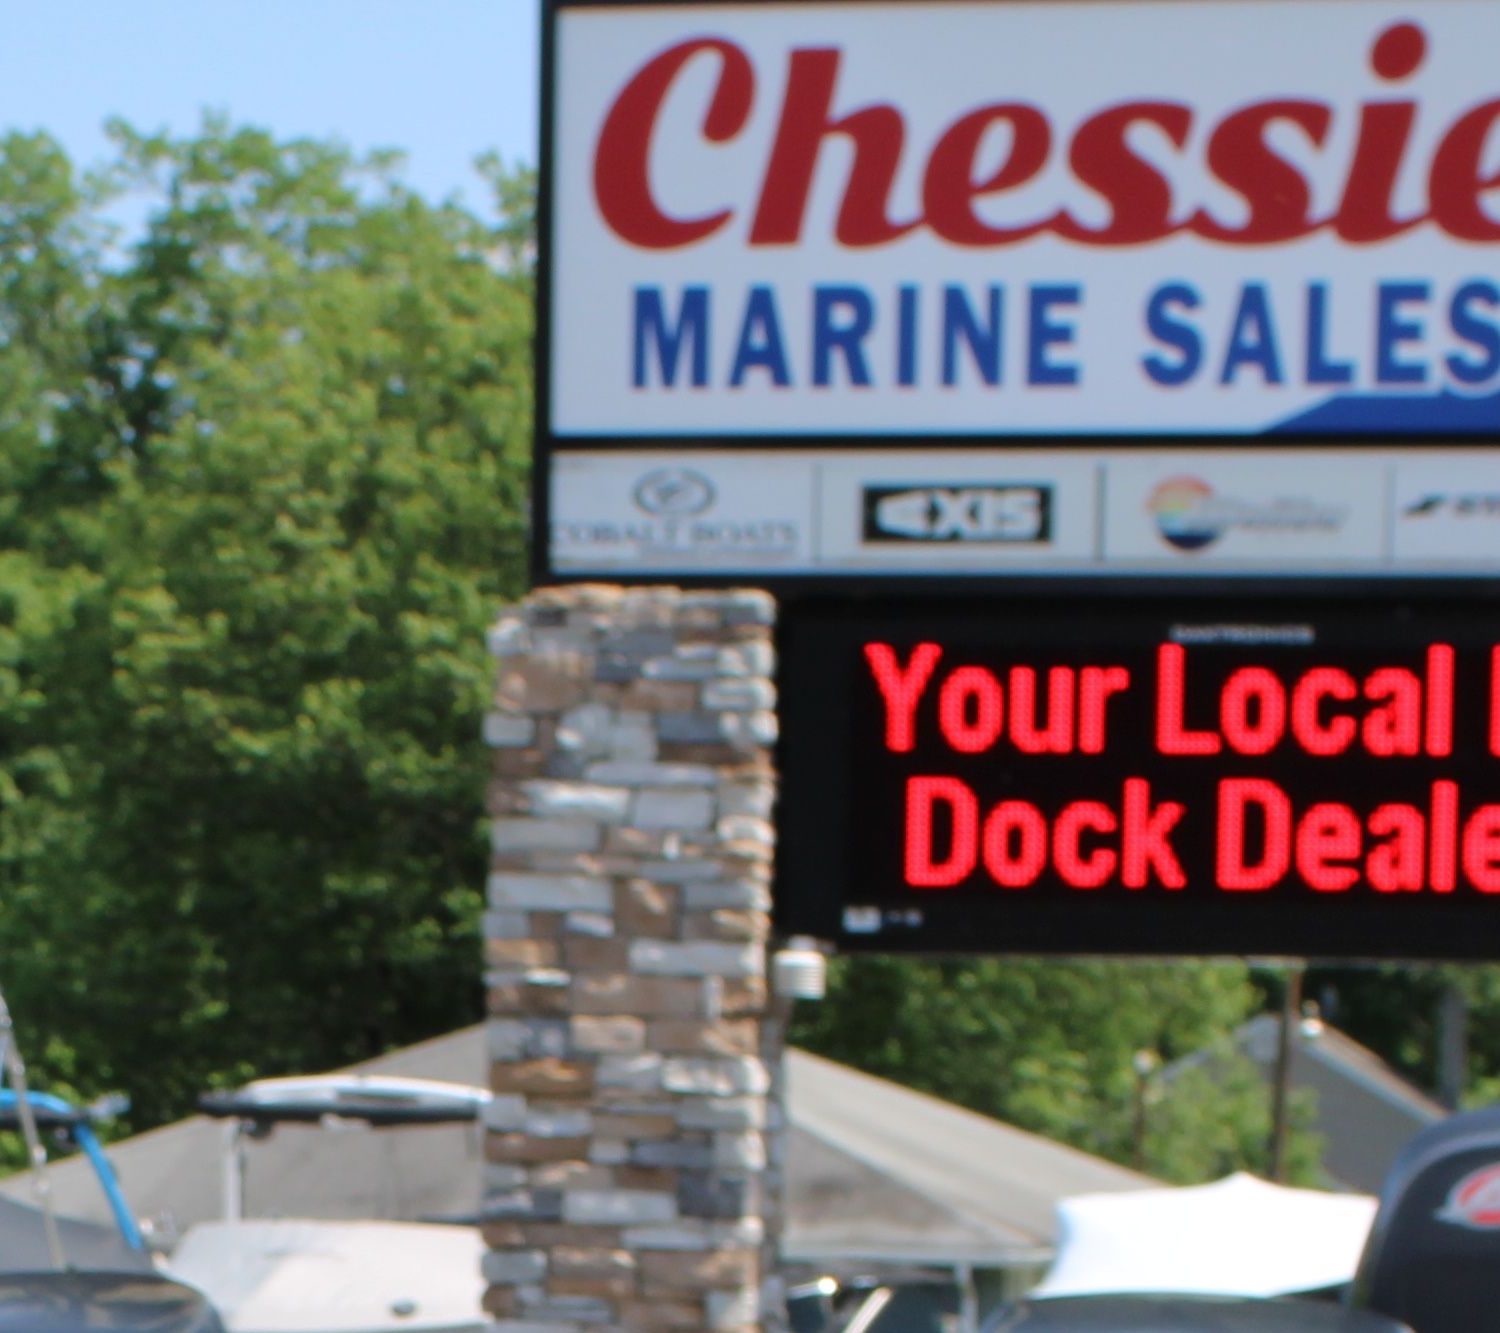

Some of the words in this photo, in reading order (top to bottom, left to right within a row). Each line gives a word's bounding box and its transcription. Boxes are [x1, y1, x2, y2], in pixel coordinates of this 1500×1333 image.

[630, 284, 1083, 389] MARINE
[864, 642, 1130, 754] Your
[1155, 643, 1454, 757] Local
[904, 775, 1188, 888] Dock
